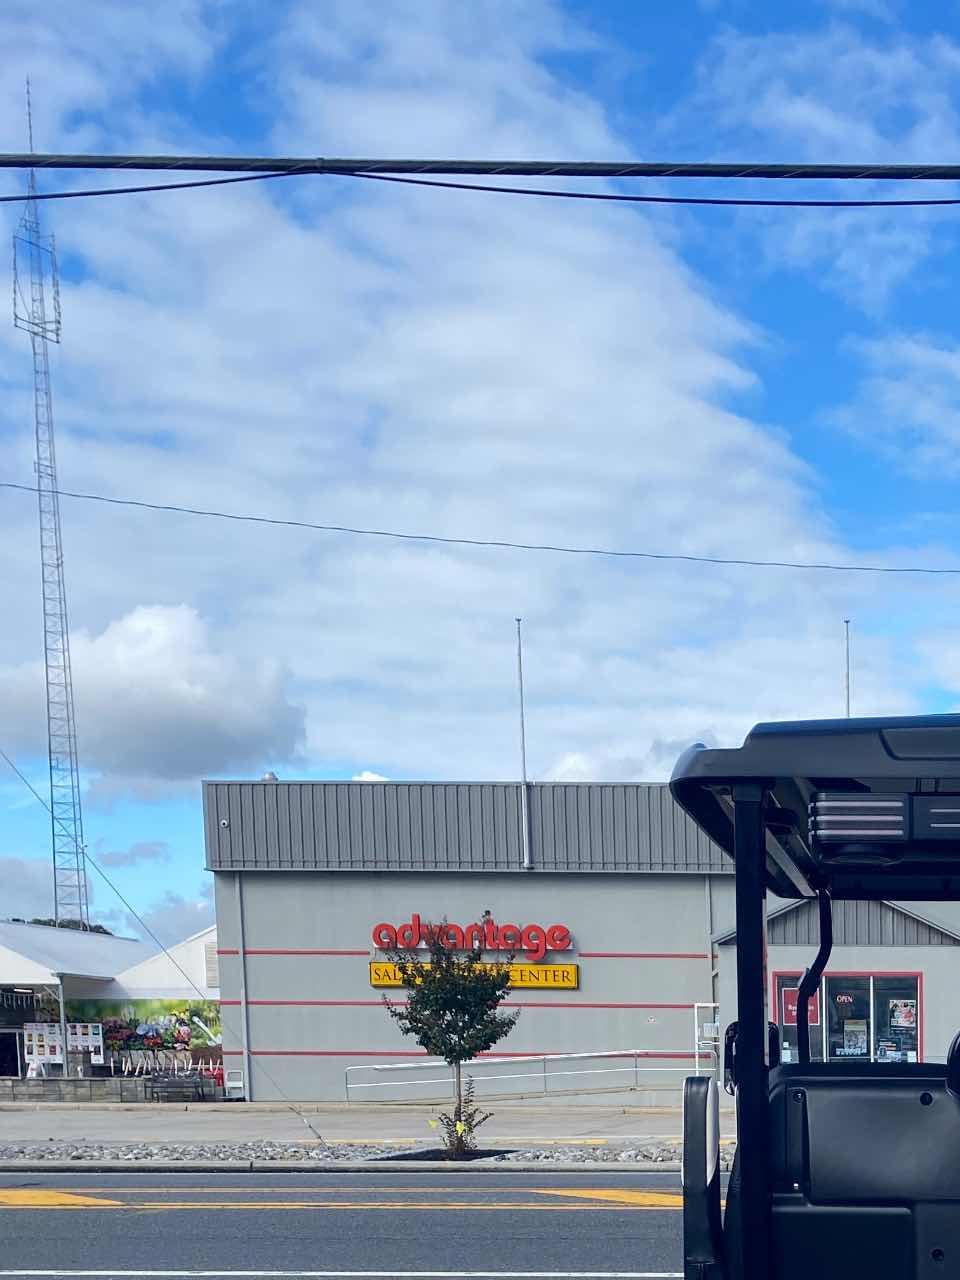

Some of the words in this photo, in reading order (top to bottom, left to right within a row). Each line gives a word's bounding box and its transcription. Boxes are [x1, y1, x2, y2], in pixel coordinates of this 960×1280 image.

[372, 913, 573, 961] advantage
[510, 969, 571, 983] CENTER
[836, 994, 853, 1003] OPEN
